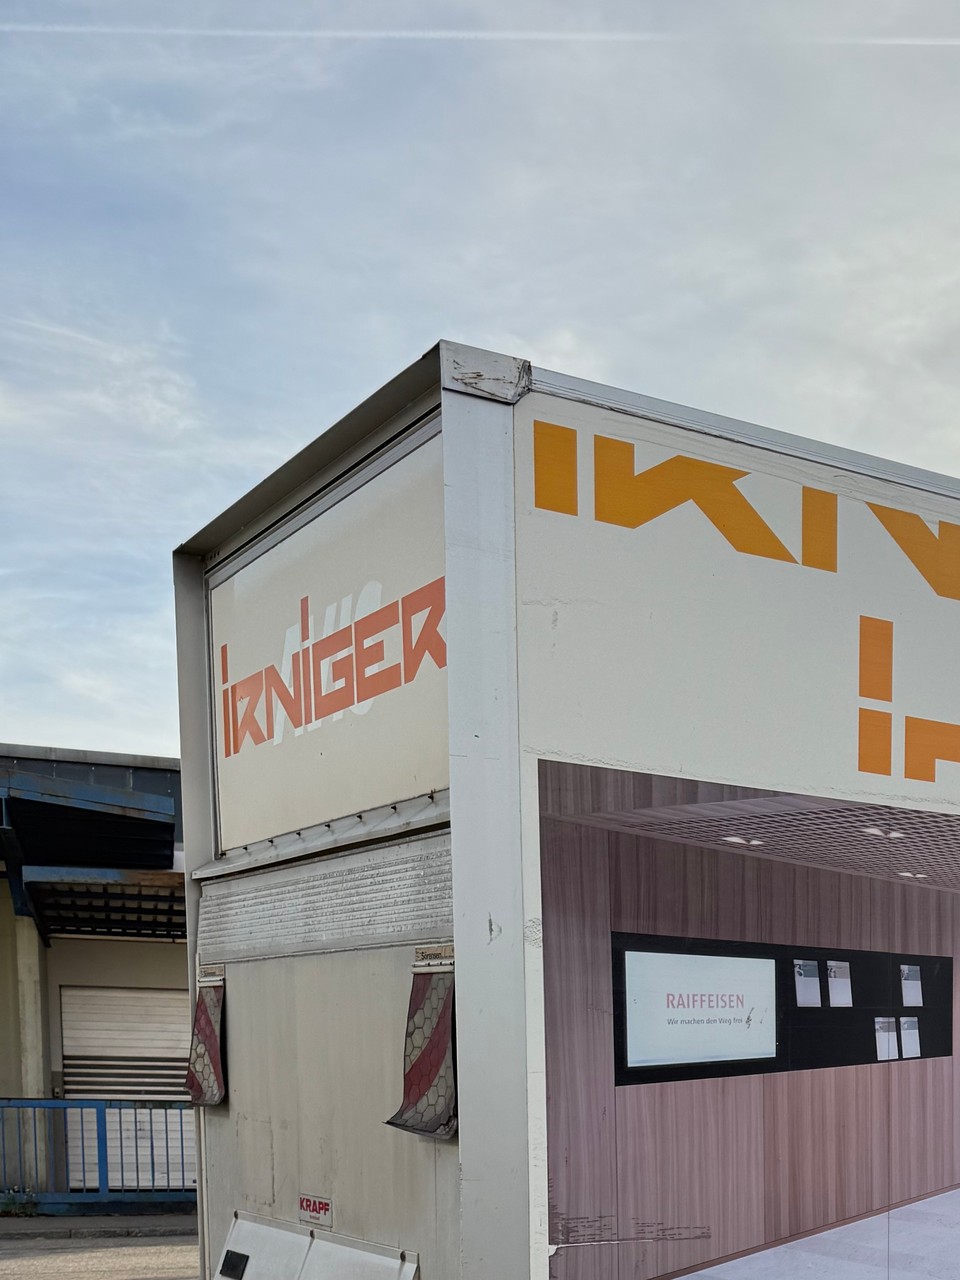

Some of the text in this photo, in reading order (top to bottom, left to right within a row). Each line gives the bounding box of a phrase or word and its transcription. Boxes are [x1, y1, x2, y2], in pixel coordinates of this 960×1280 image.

[666, 993, 744, 1009] RAIFFEISEN
[680, 1017, 705, 1025] machen
[719, 1017, 731, 1026] Weg
[299, 1196, 330, 1217] KRAPF
